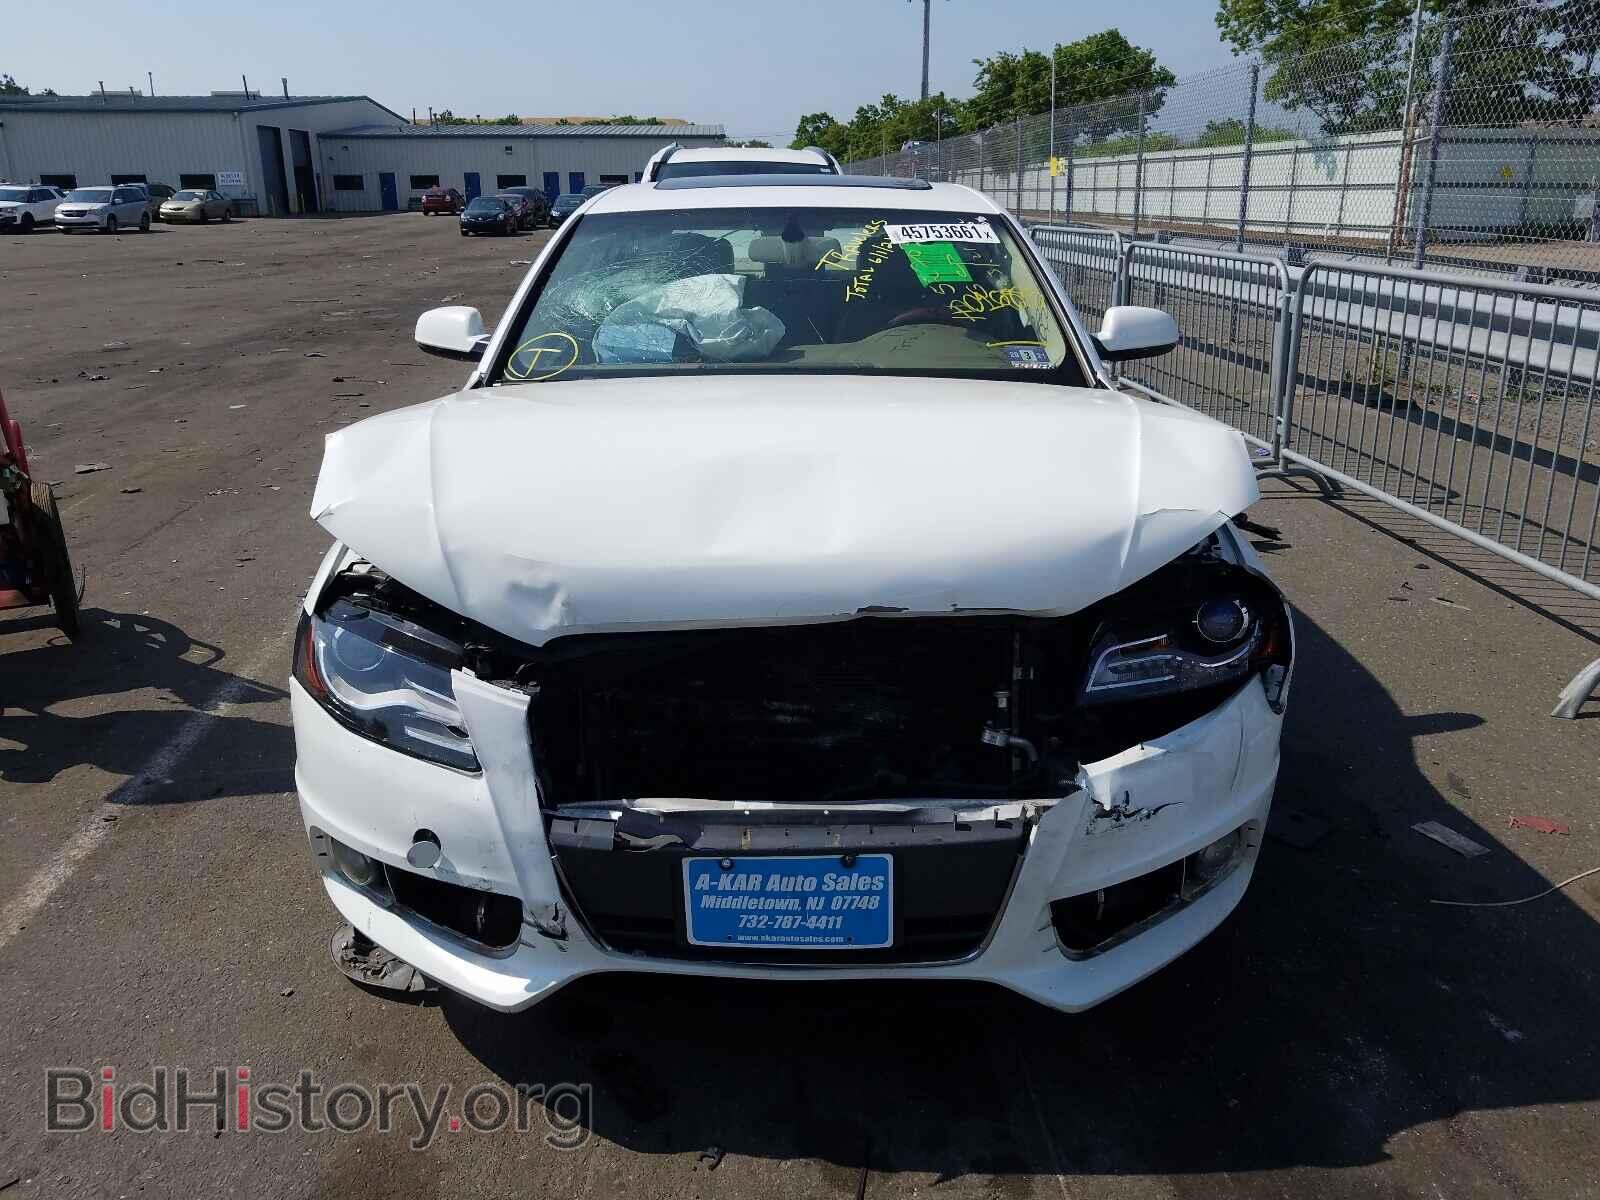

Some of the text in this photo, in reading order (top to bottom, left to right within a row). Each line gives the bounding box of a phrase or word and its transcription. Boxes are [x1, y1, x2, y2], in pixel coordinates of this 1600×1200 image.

[901, 225, 982, 239] 45753661
[845, 267, 874, 302] TOTAL
[1023, 351, 1032, 360] 3
[695, 872, 885, 892] A-KAR Auto Sales
[806, 896, 826, 911] NJ
[831, 895, 881, 911] 07748
[738, 914, 844, 930] 732-787-4411
[737, 935, 845, 943] www.akarautosales.com
